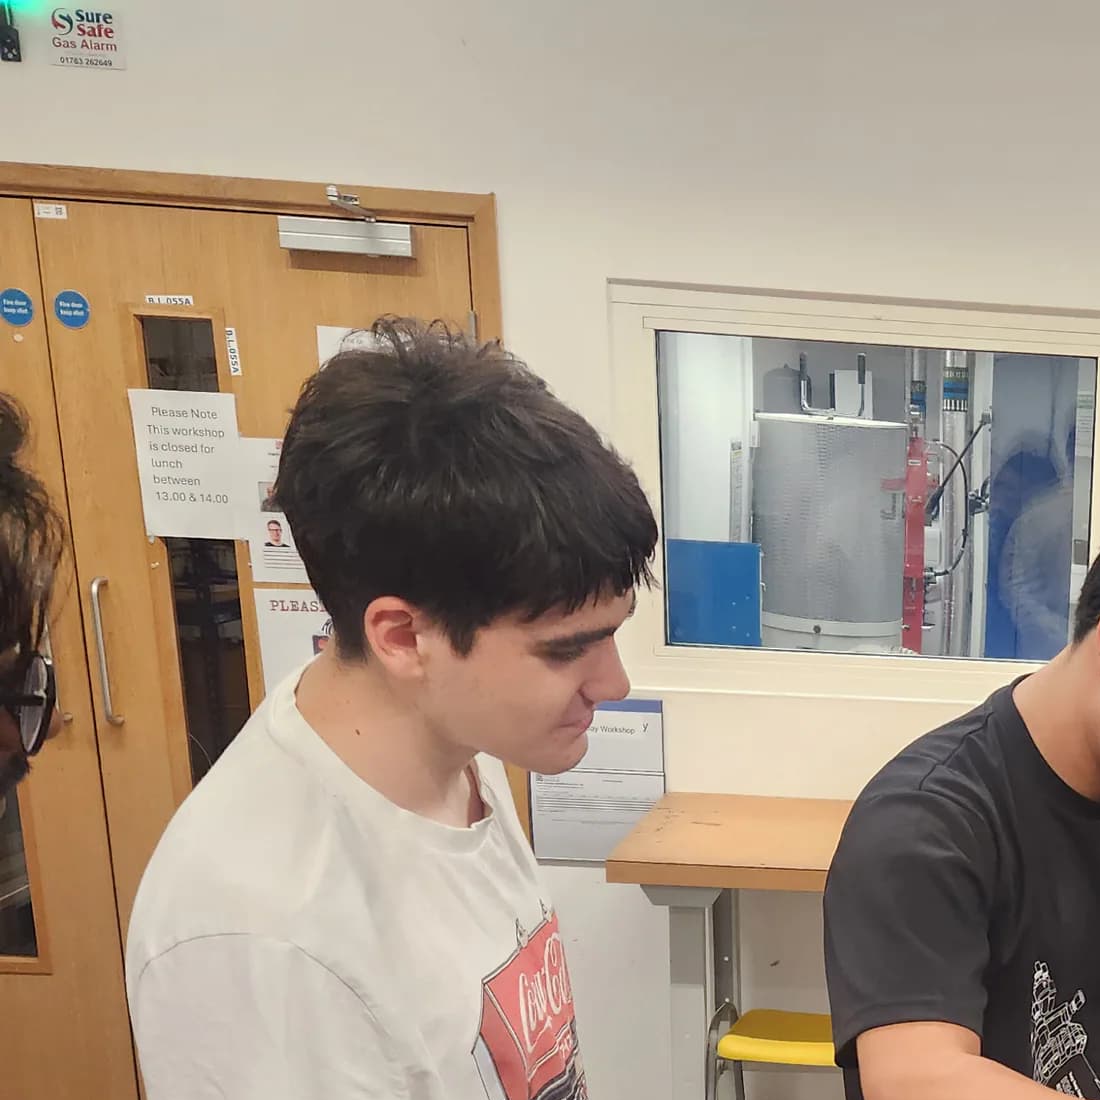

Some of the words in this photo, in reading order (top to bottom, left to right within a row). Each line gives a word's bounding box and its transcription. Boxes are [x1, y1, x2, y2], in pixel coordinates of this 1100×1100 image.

[75, 9, 113, 24] Sure
[77, 24, 114, 38] Safe
[52, 37, 77, 49] Gas
[80, 39, 117, 52] Alarm
[151, 406, 188, 418] Please
[190, 408, 218, 420] Note
[147, 424, 169, 435] This
[171, 426, 225, 438] workshop
[149, 440, 159, 451] is
[161, 442, 198, 453] closed
[200, 443, 215, 454] for
[151, 457, 183, 469] lunch
[153, 474, 201, 486] between
[156, 491, 186, 502] 13.00
[188, 492, 197, 502] &
[200, 493, 229, 504] 14.00
[599, 725, 636, 735] Workshop
